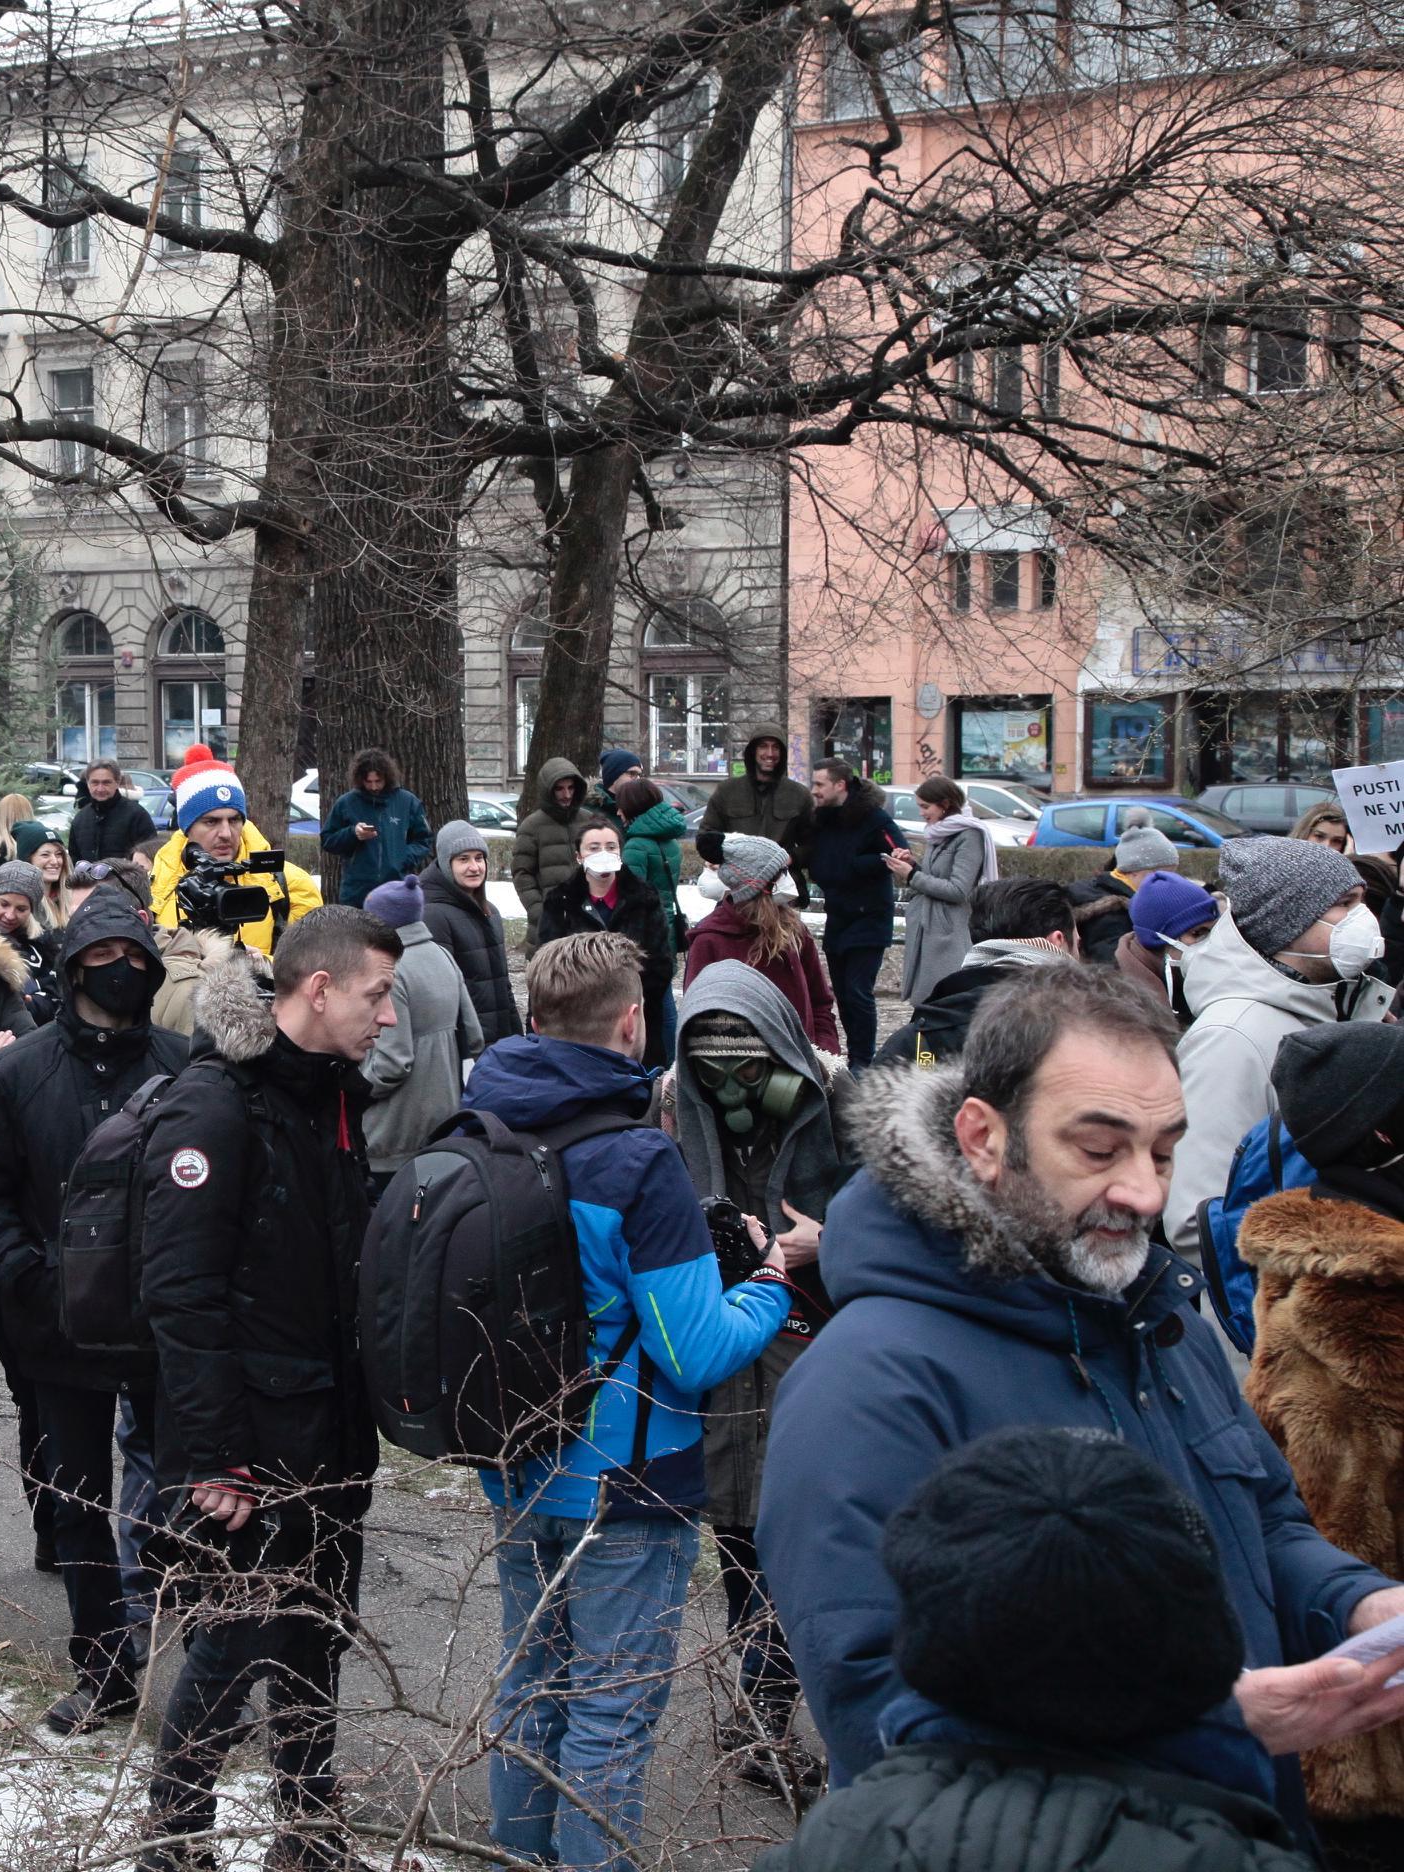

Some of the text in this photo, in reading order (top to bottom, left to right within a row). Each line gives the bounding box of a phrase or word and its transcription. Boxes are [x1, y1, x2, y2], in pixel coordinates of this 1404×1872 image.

[1353, 780, 1400, 796] PUSTI
[1364, 801, 1404, 816] NE V
[919, 1051, 933, 1071] 50
[746, 1267, 785, 1281] anon
